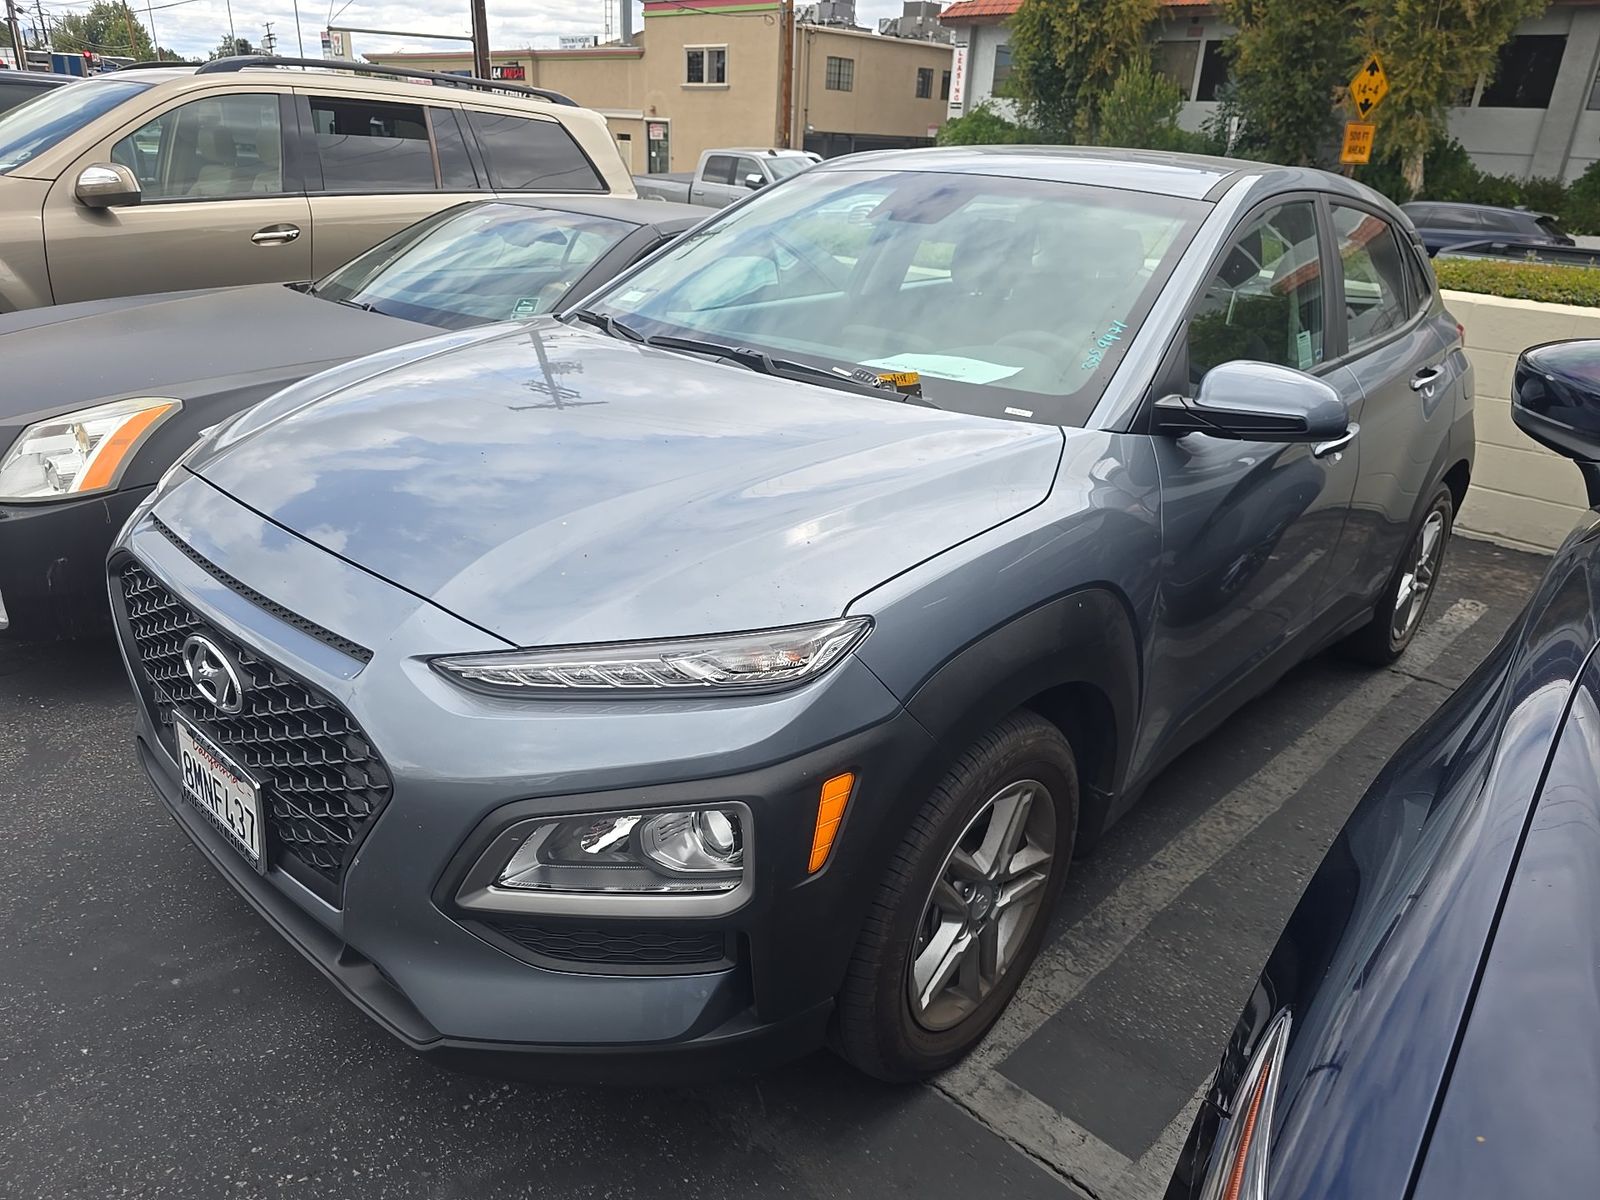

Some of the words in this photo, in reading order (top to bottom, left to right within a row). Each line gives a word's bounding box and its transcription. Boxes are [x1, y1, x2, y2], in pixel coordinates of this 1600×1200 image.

[954, 50, 963, 101] LEASING
[1348, 145, 1366, 155] AHEAD
[183, 750, 256, 850] 8MNF437
